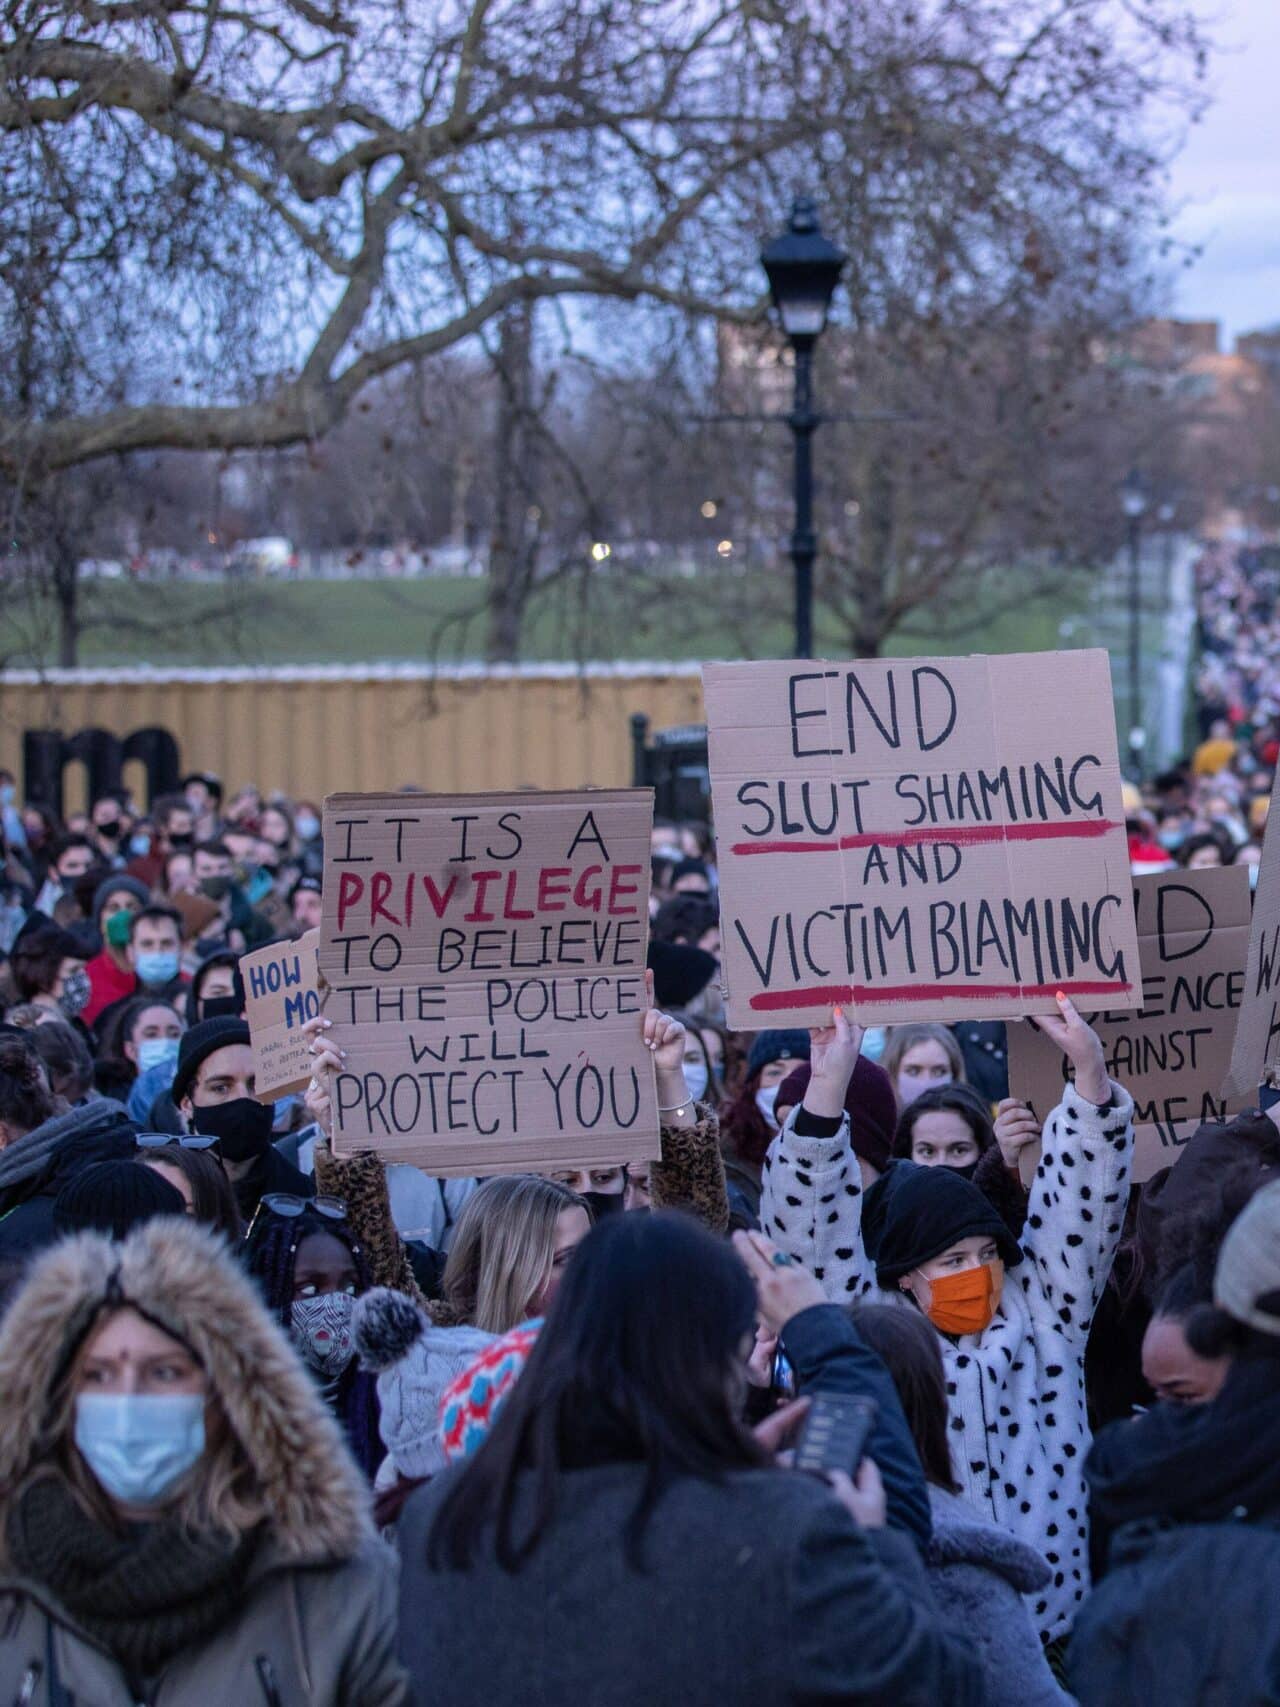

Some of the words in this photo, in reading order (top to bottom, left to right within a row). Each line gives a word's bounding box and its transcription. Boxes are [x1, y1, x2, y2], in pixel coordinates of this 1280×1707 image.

[789, 666, 957, 758] END
[737, 781, 871, 837] SLUT
[895, 755, 1104, 826] SHAMING
[332, 817, 420, 862] IT
[449, 812, 524, 862] IS
[567, 811, 609, 861] A
[863, 842, 962, 887] AND
[337, 864, 642, 931] PRIVILEGE
[332, 935, 402, 974] TO
[437, 920, 641, 974] BELIEVE
[735, 903, 917, 988] VICTIM
[929, 895, 1127, 985] BLAMING
[250, 956, 300, 999] HOW
[332, 985, 446, 1026] THE
[487, 977, 641, 1025] POLICE
[284, 990, 320, 1029] MO
[410, 1028, 549, 1064] WILL
[1062, 1028, 1213, 1083] AINST
[336, 1070, 525, 1134] PROTECT
[543, 1064, 640, 1129] YOU
[1131, 1091, 1227, 1147] MEN
